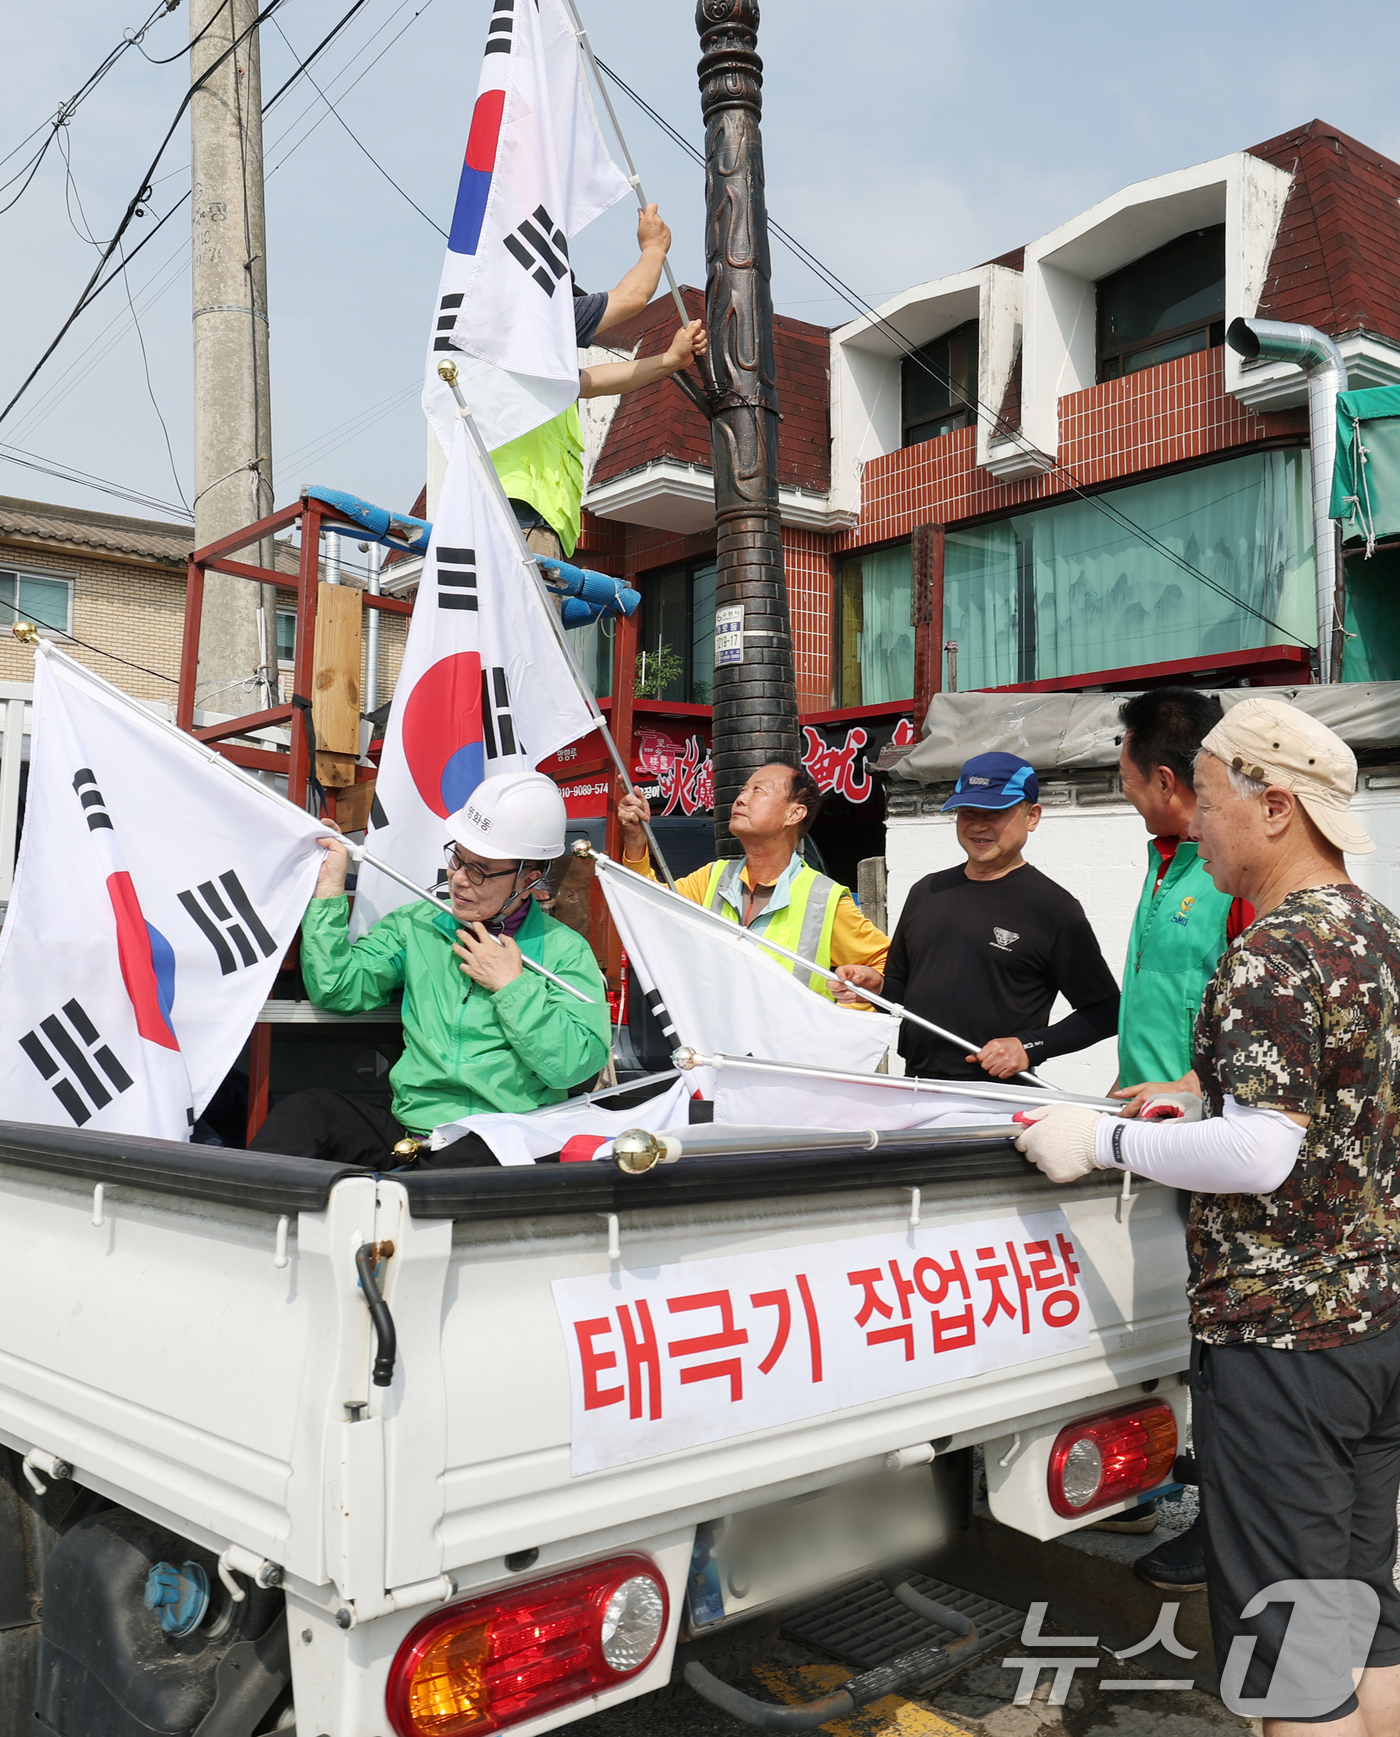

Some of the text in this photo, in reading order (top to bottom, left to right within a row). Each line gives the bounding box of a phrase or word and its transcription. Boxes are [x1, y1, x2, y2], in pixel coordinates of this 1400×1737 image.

[722, 609, 740, 618] 수원시
[557, 747, 578, 762] 망향루
[466, 805, 492, 831] 영화동
[573, 1233, 1081, 1421] 태극기 작업차량
